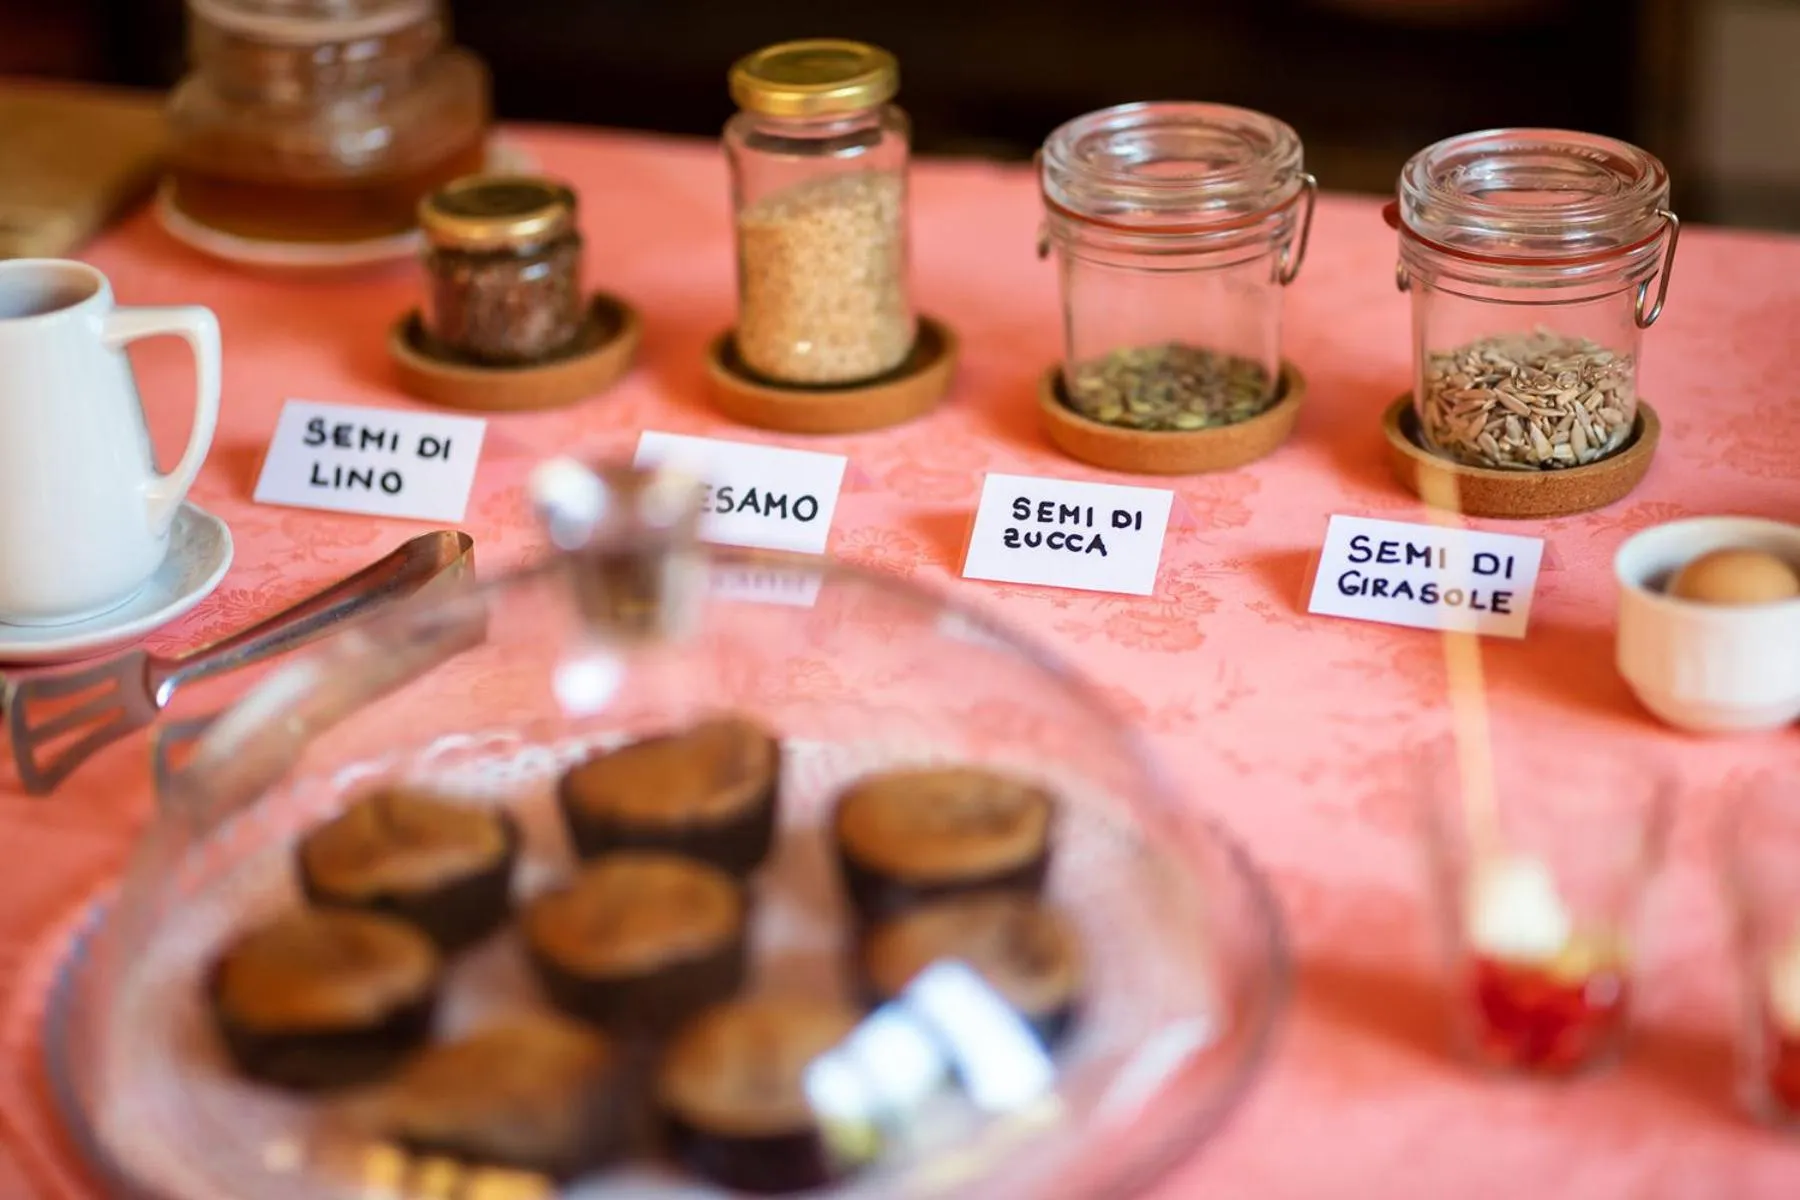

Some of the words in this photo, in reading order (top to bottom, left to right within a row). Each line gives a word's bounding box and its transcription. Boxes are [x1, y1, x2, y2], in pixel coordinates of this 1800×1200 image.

[303, 417, 399, 451] SEMI
[417, 436, 452, 460] DI
[310, 462, 403, 494] LINO
[699, 480, 819, 522] ESAMO
[1012, 496, 1093, 528] SEMI
[1111, 509, 1142, 531] DI
[1003, 527, 1108, 557] ZUCCA
[1348, 535, 1446, 569] SEMI
[1472, 552, 1514, 579] DI
[1337, 570, 1513, 615] GIRASOLE
